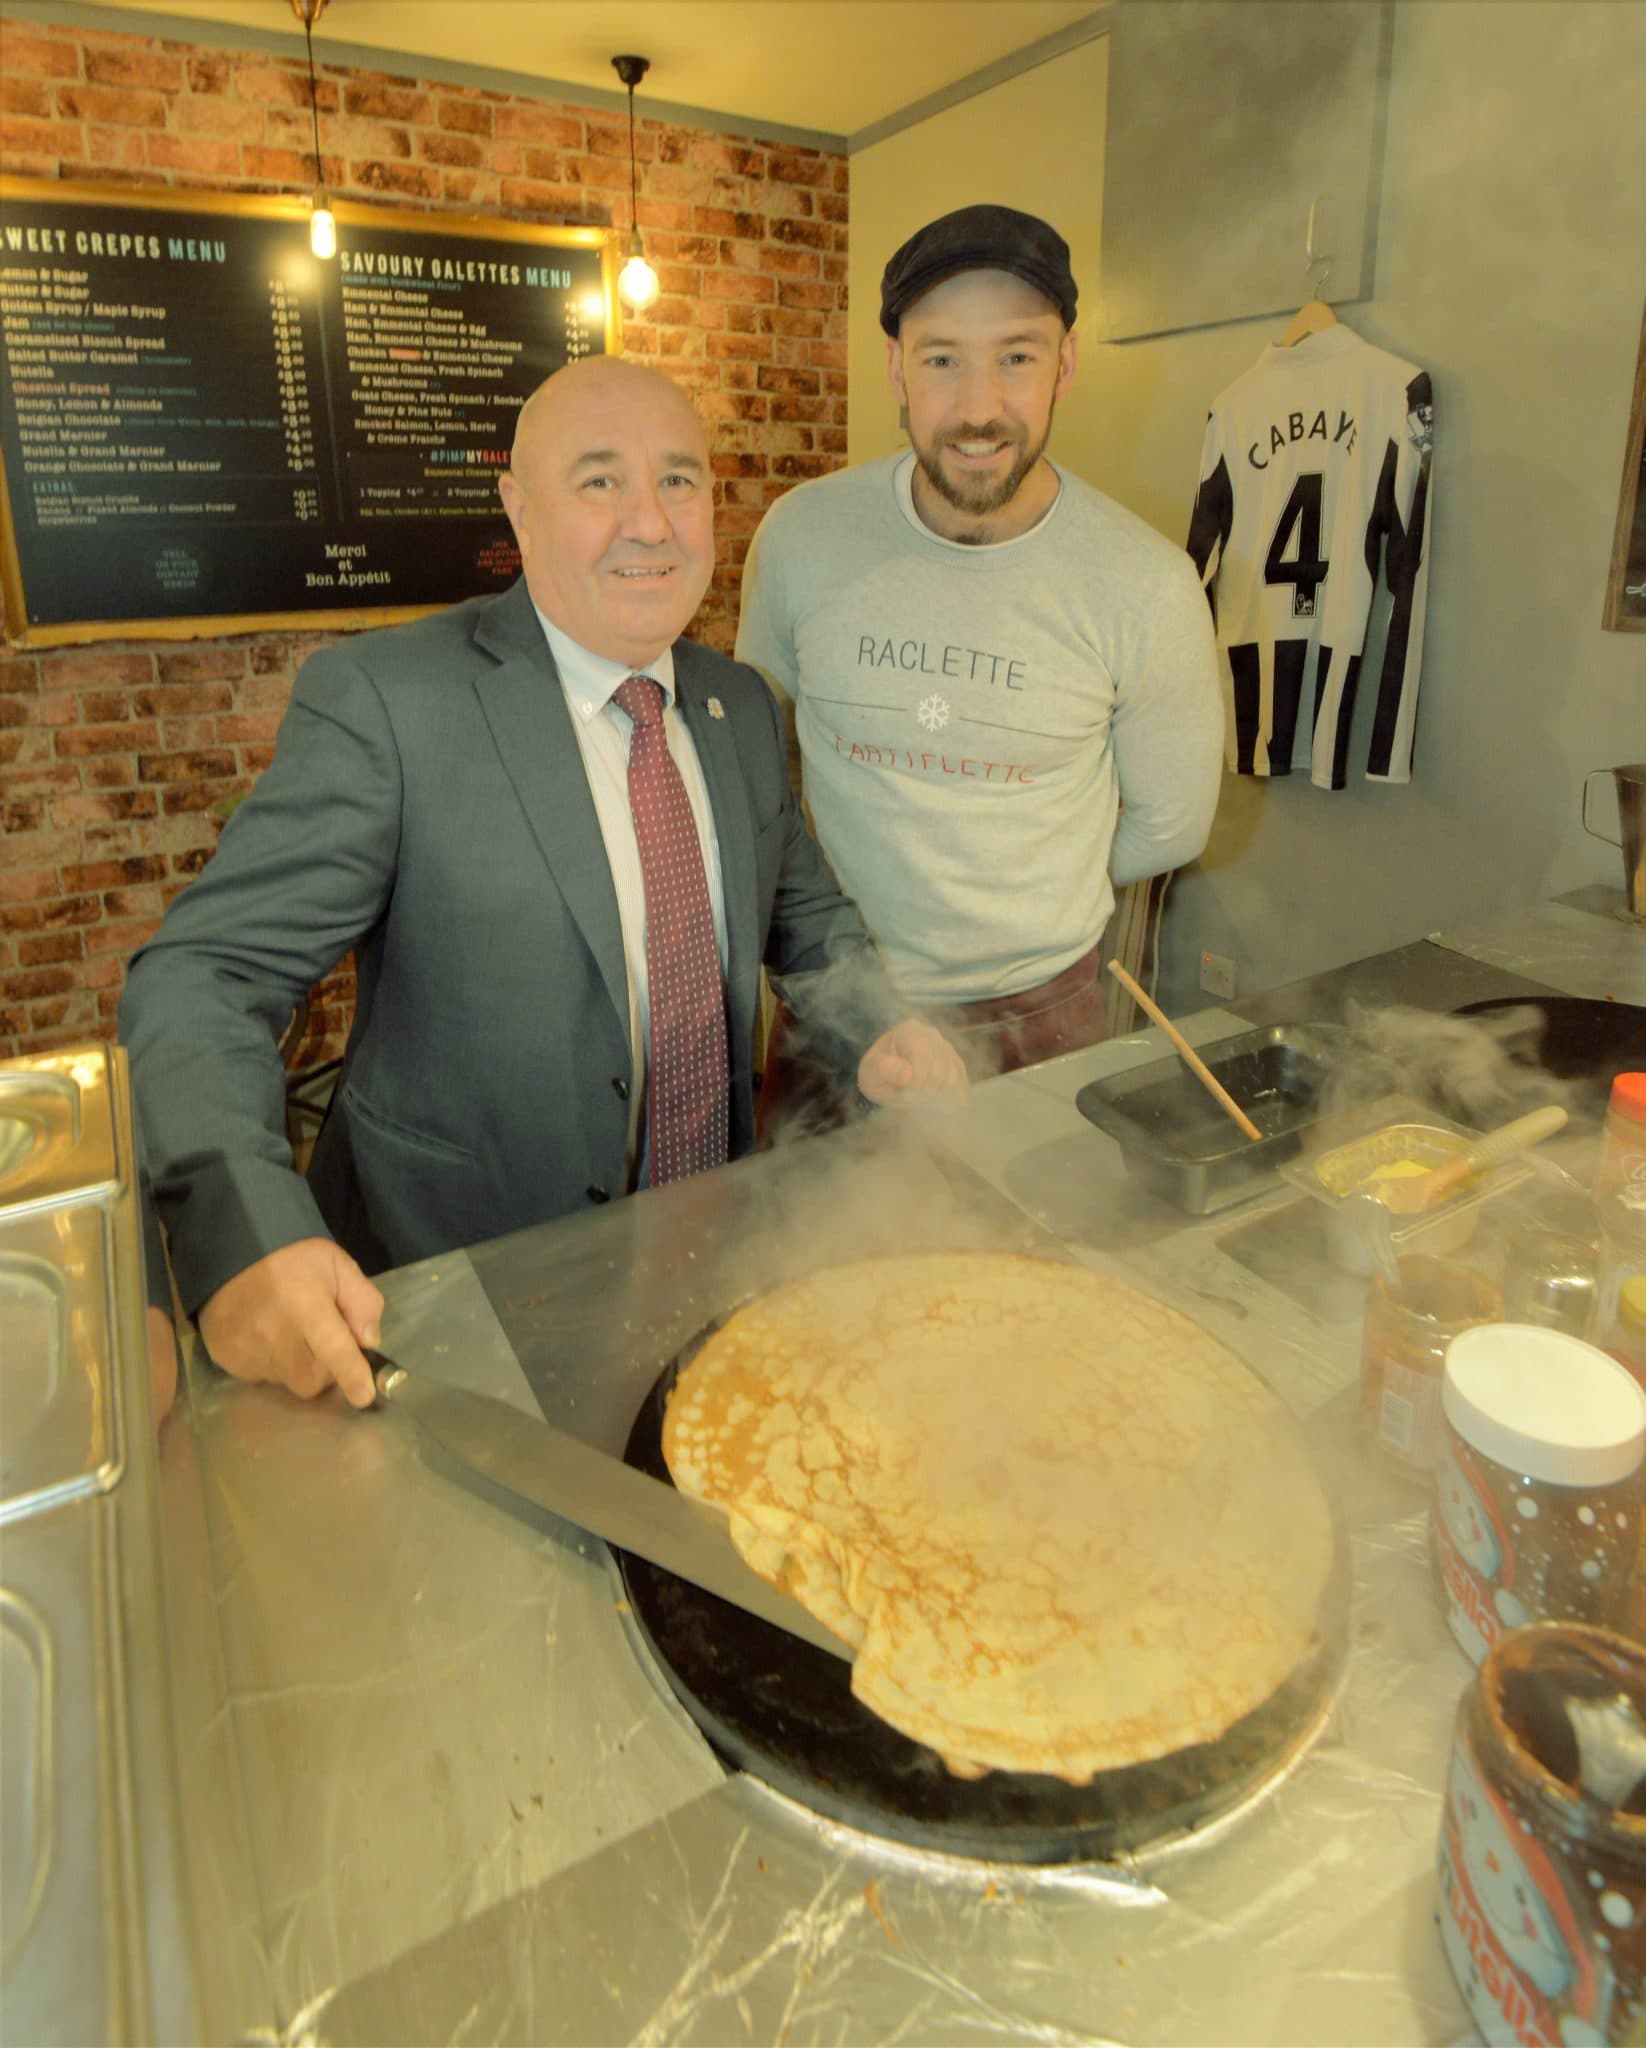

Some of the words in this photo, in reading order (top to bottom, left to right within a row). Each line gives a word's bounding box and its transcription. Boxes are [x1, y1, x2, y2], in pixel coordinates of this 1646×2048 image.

[76, 230, 160, 259] CREPES
[168, 237, 226, 263] MENU
[341, 251, 424, 276] SAVOURY
[526, 267, 571, 289] MENU
[470, 338, 522, 352] Mushrooms
[373, 375, 428, 389] Mushrooms
[325, 544, 367, 558] Merci
[1263, 471, 1330, 618] 4
[338, 560, 352, 571] et
[306, 573, 334, 587] Bon
[857, 635, 1027, 690] RACLETTE
